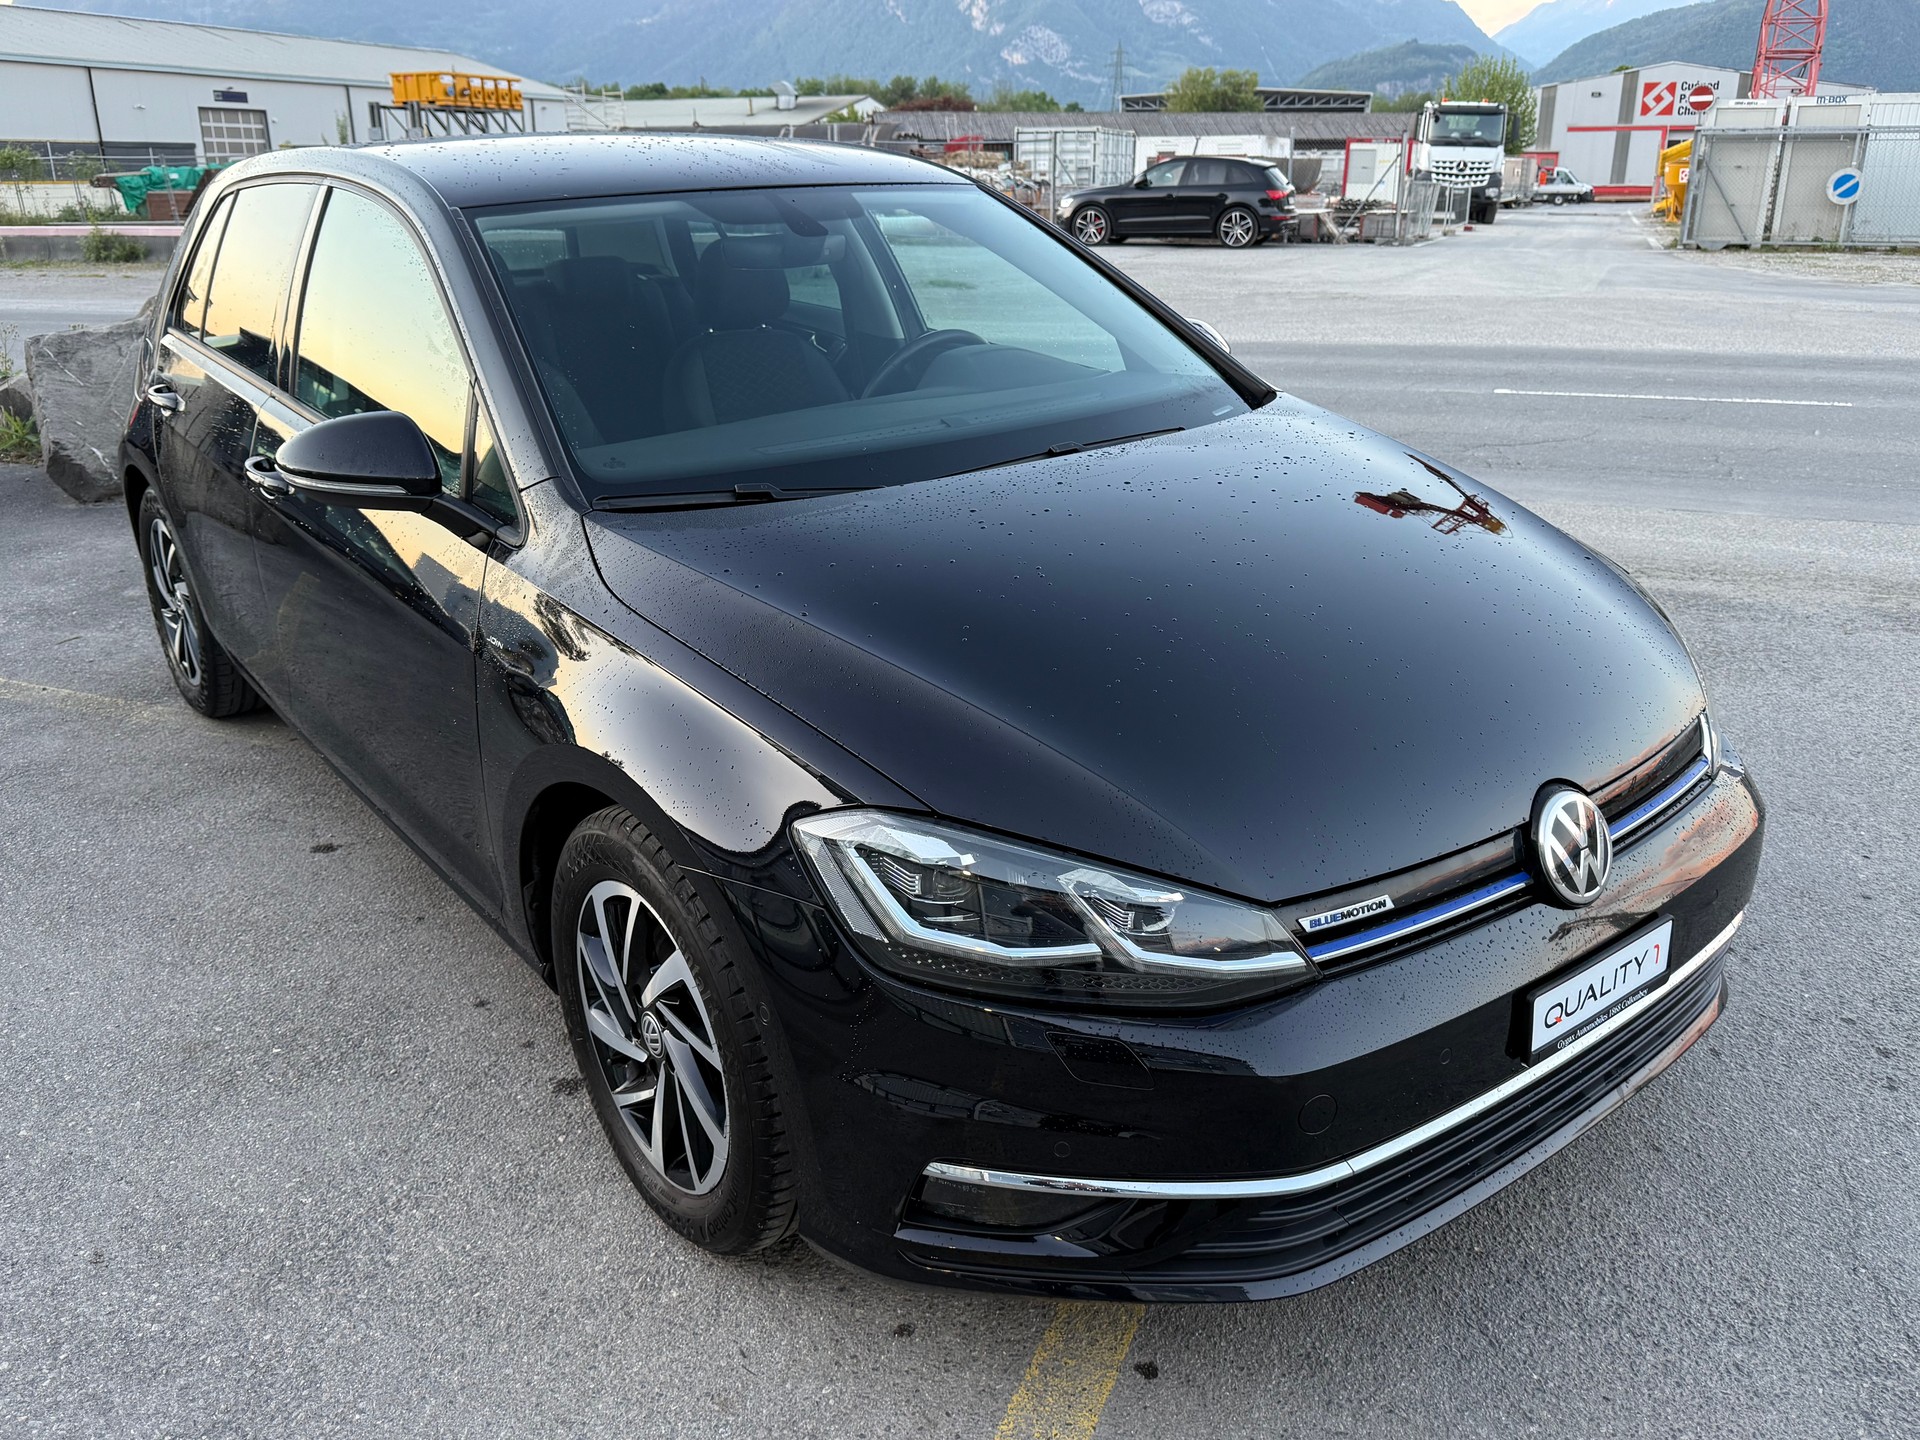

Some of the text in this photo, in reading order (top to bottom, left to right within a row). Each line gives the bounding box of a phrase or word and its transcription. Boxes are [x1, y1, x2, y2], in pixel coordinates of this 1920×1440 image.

[1541, 792, 1611, 903] VW
[1309, 899, 1387, 929] BLUEMOTION
[1544, 943, 1660, 1029] QUALITY 1
